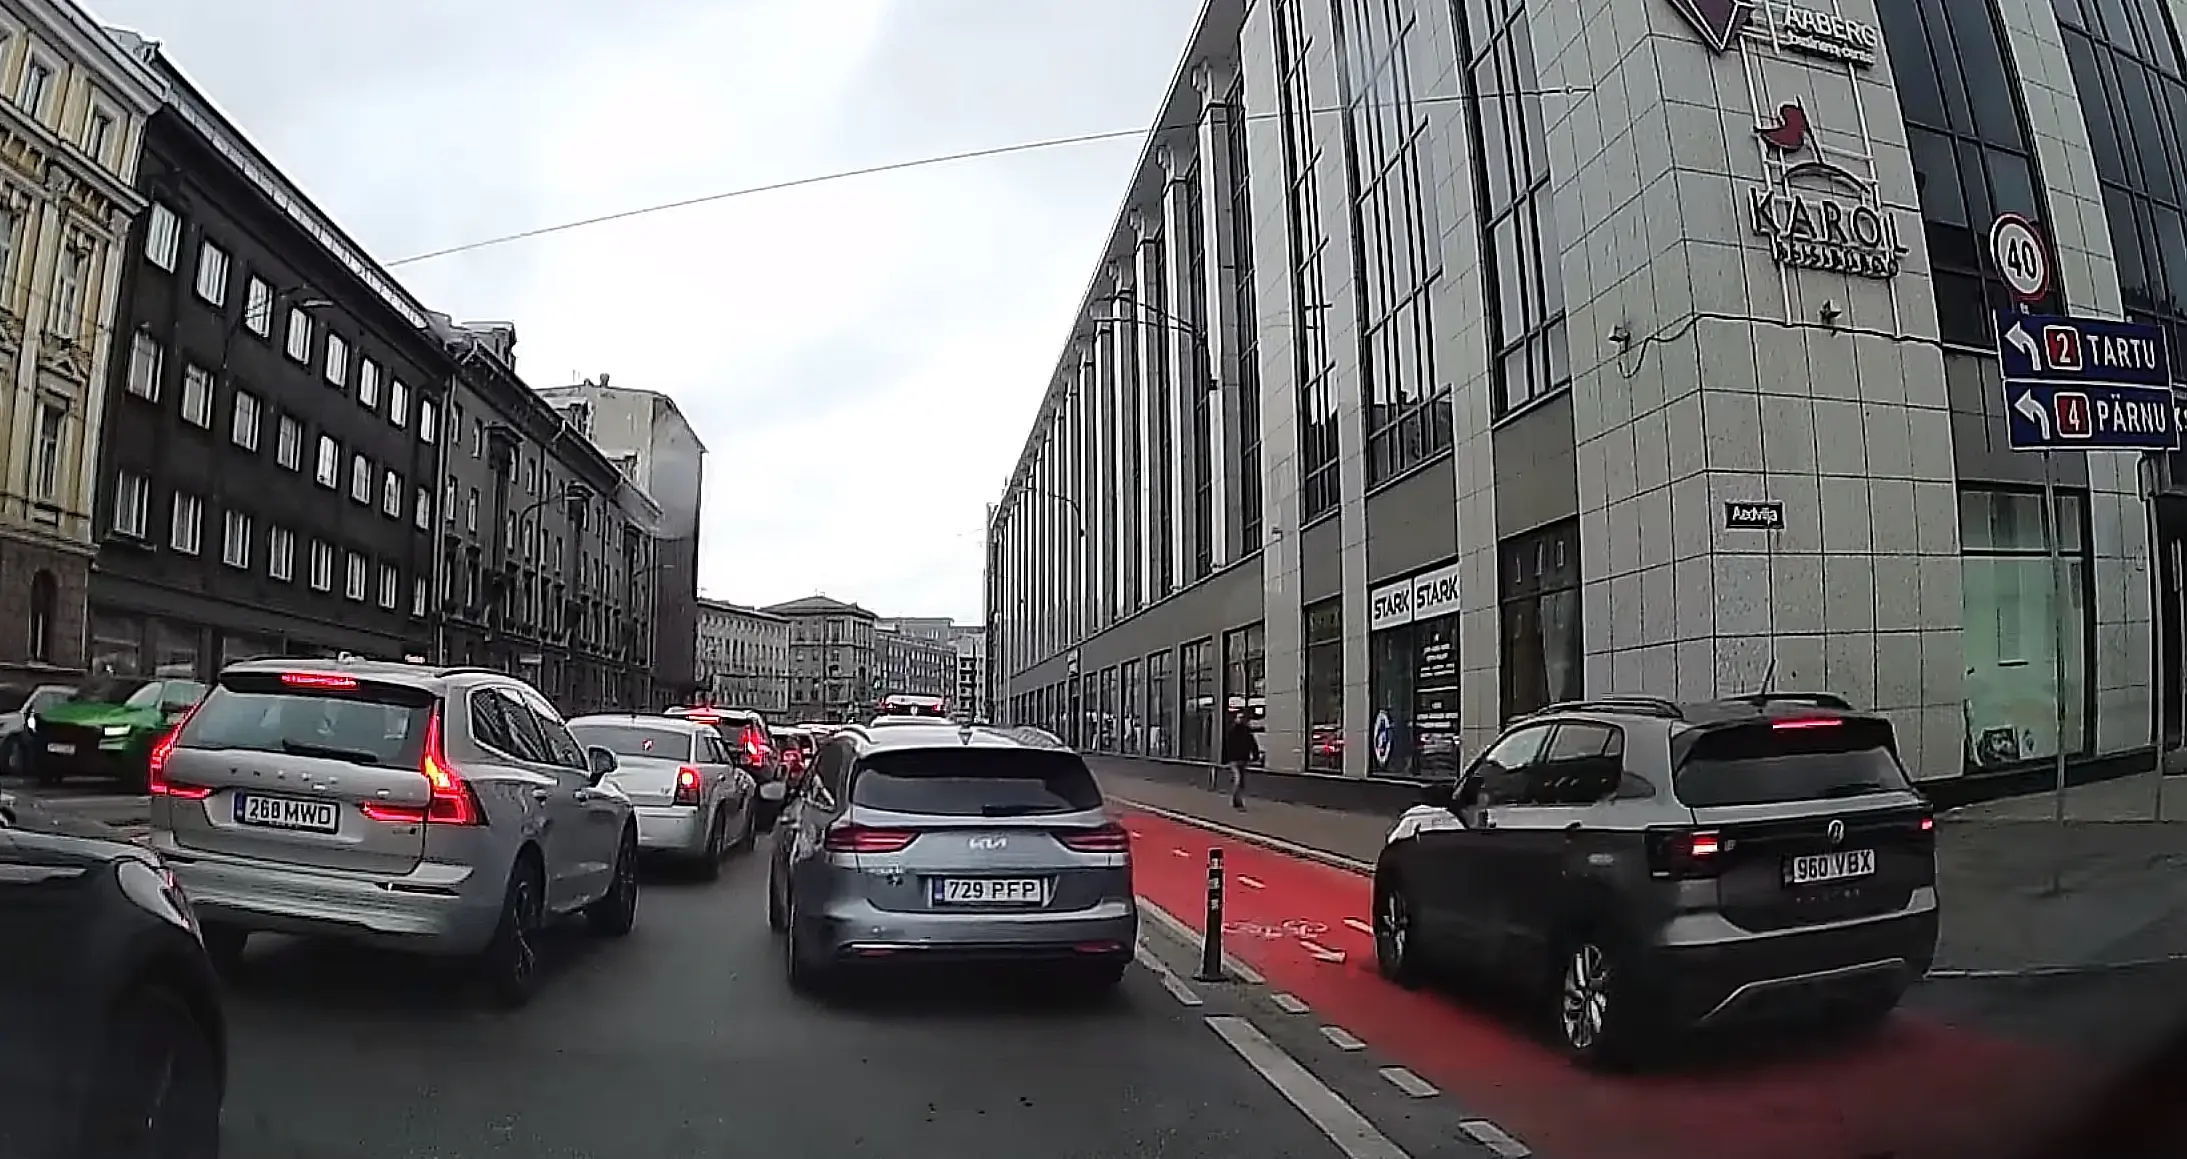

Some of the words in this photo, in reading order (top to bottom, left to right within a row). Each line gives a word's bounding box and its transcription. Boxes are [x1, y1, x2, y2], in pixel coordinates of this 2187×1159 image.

[1749, 188, 1909, 254] KAROL
[2008, 238, 2037, 280] 40
[2056, 333, 2071, 363] 2
[2086, 334, 2156, 369] TARTU
[2068, 399, 2080, 431] 4
[2097, 393, 2166, 433] PÄRNU
[1375, 589, 1410, 620] STARK
[1417, 575, 1458, 609] STARK
[1797, 857, 1829, 880] 960
[1835, 850, 1872, 875] VBX
[949, 882, 984, 899] 729
[992, 882, 1035, 899] PFP
